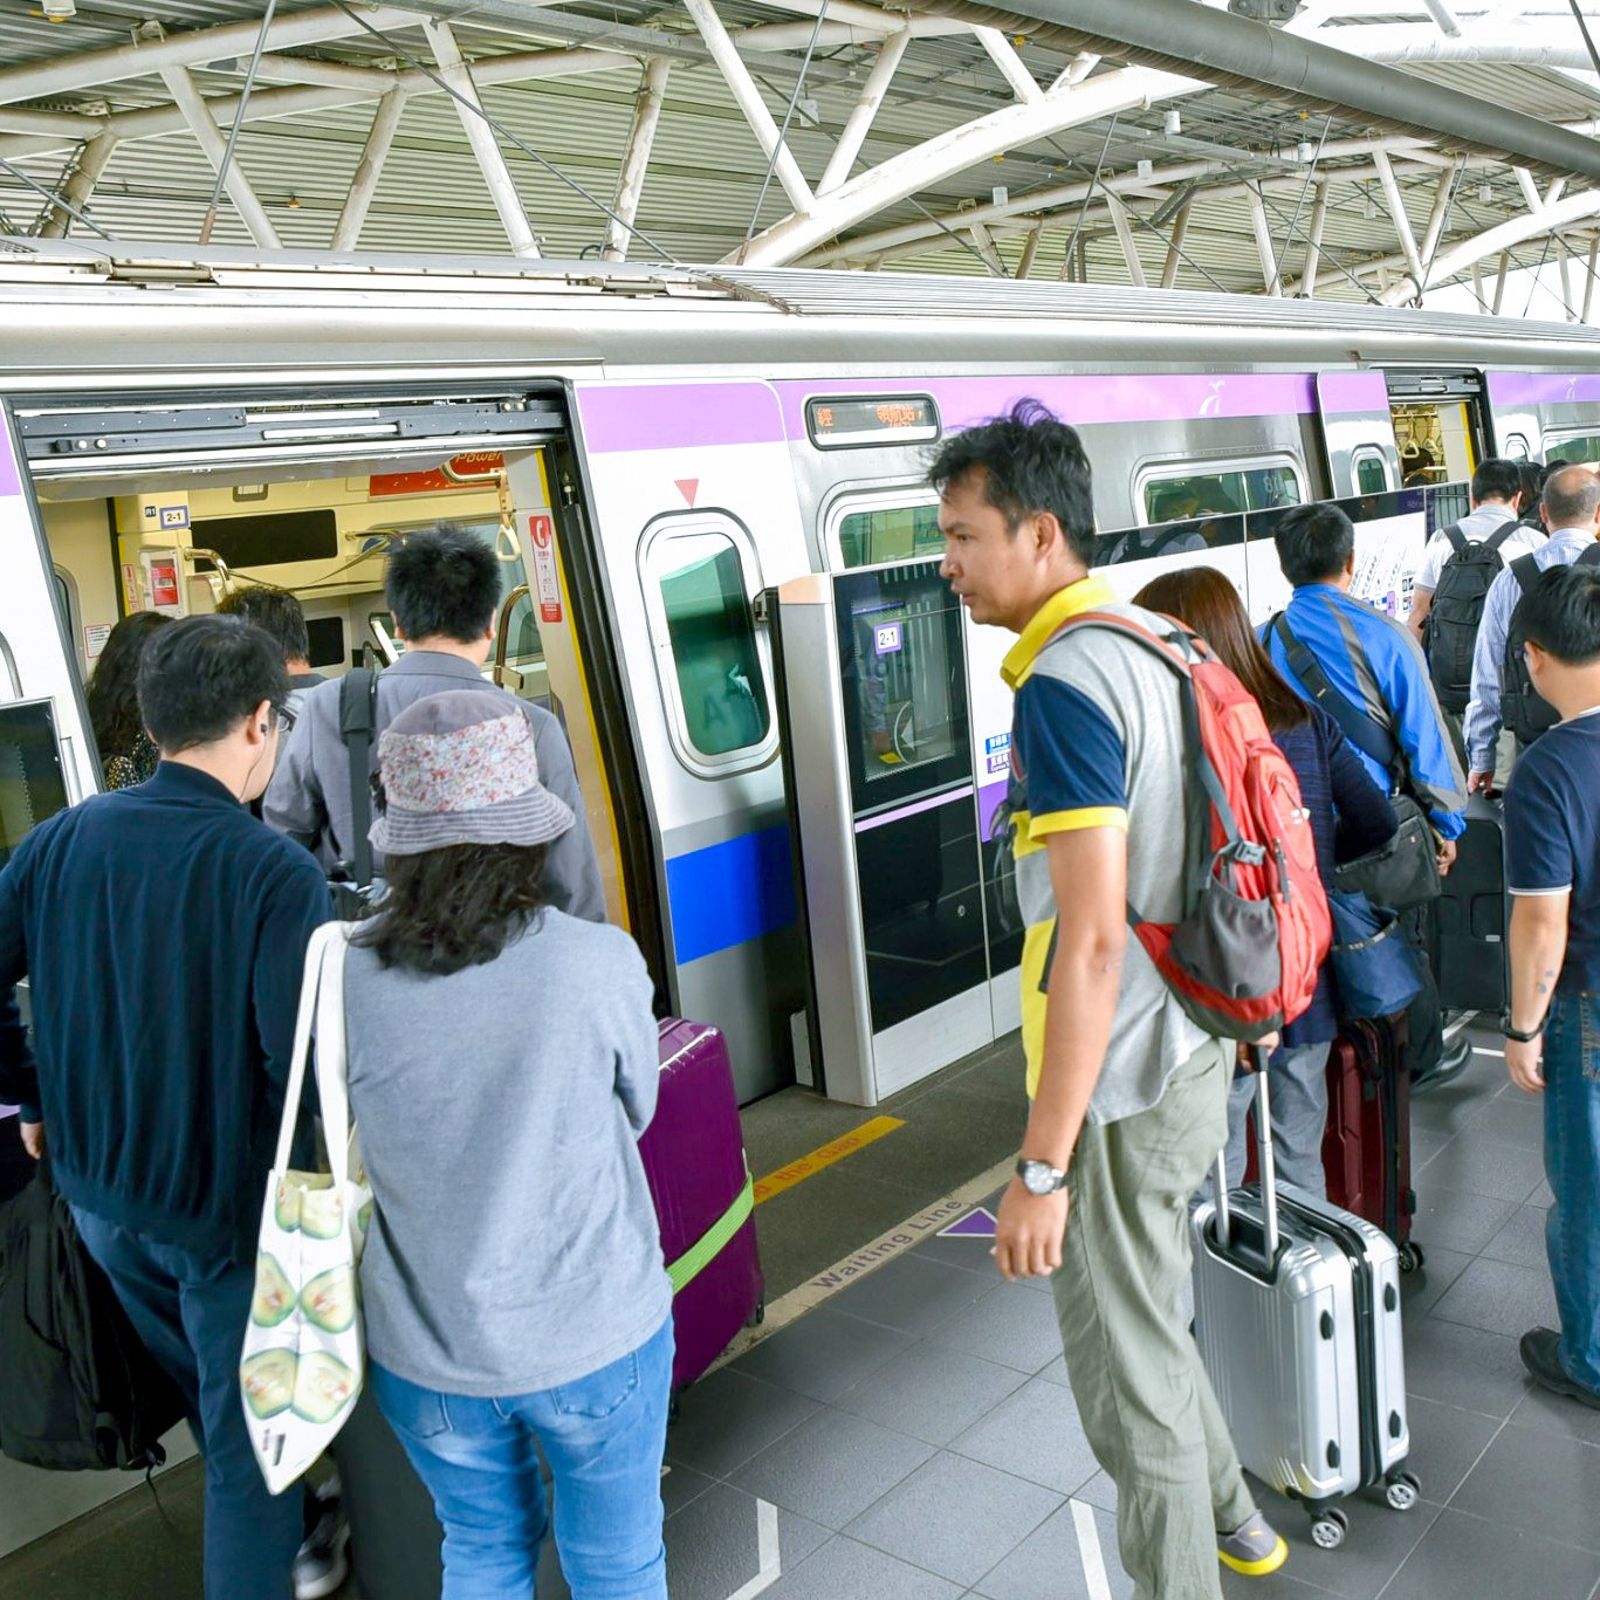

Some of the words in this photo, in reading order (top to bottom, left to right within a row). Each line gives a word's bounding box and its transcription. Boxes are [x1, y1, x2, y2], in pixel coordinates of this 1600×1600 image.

[167, 512, 181, 522] 2-1
[879, 631, 895, 646] 2-1
[811, 1233, 913, 1288] Waiting
[908, 1200, 962, 1230] Line
